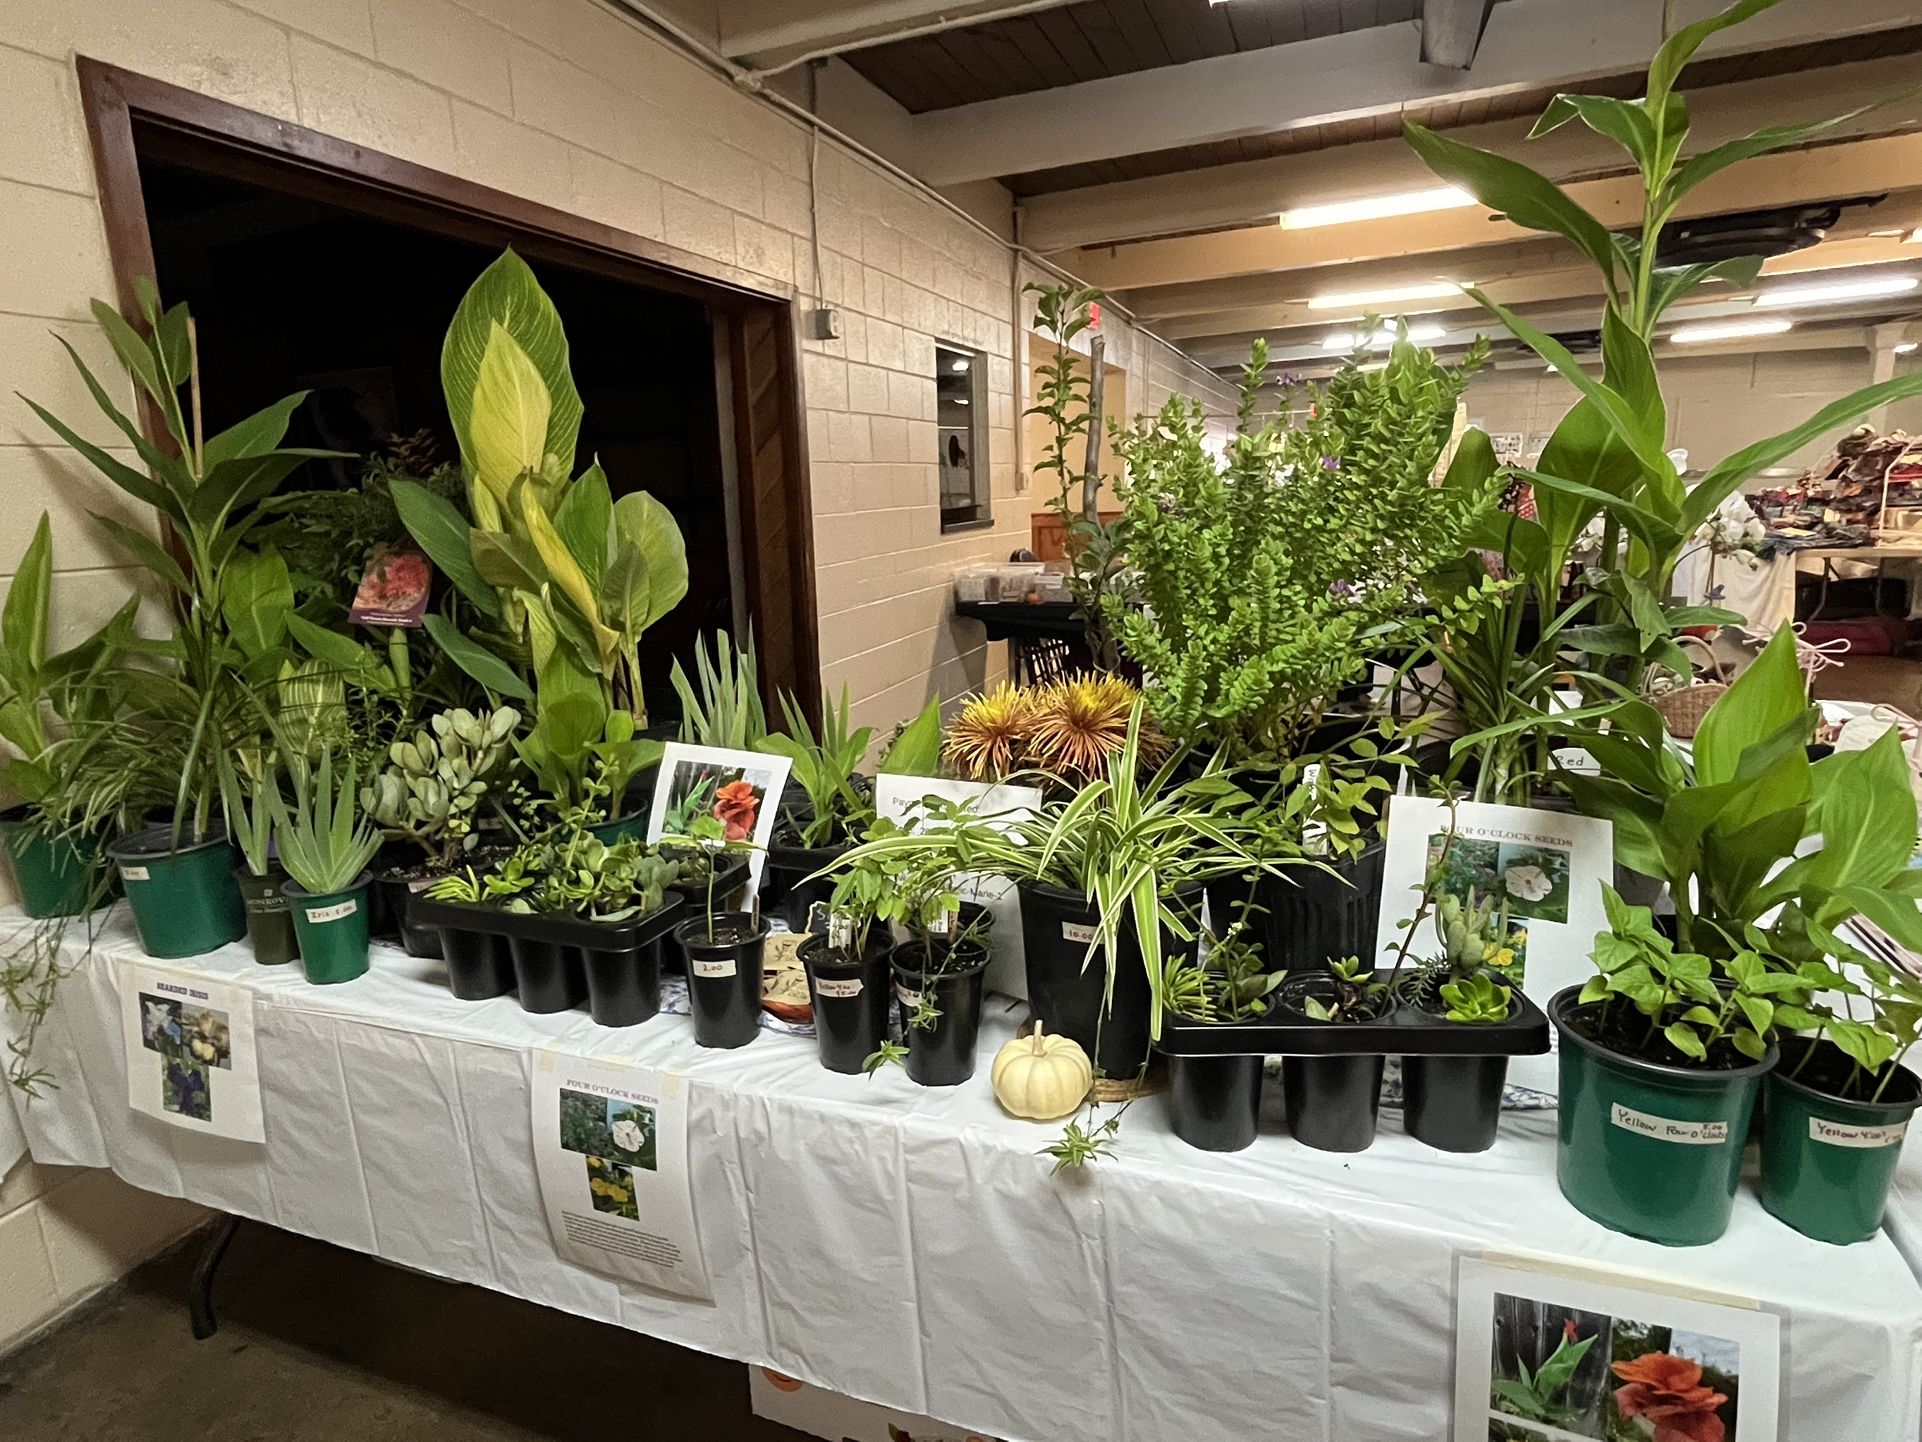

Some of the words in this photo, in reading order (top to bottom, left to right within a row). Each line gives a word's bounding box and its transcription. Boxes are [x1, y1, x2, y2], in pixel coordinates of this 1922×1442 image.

[1477, 828, 1533, 841] O'CLOCK
[1535, 835, 1574, 847] SEEDS
[592, 1084, 630, 1098] O'CLOCK
[631, 1092, 659, 1104] SEEDS
[1618, 1109, 1657, 1132] Yellow
[1817, 1122, 1859, 1139] Yellow
